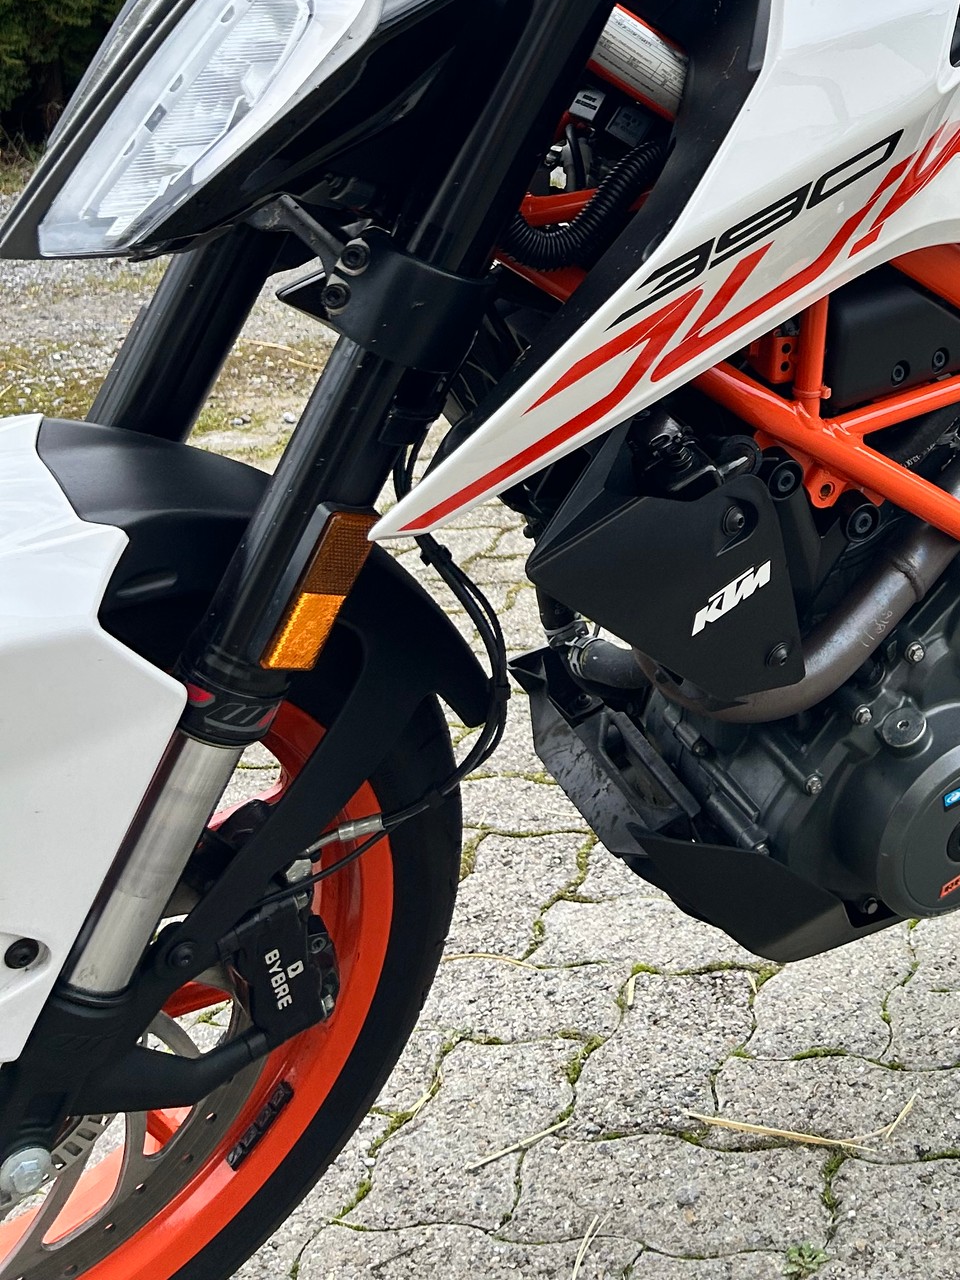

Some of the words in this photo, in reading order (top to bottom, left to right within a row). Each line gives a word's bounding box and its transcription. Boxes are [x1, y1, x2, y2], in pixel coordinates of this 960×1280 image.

[603, 128, 904, 333] 390
[691, 559, 771, 637] KTM
[264, 948, 293, 1010] BYBRE
